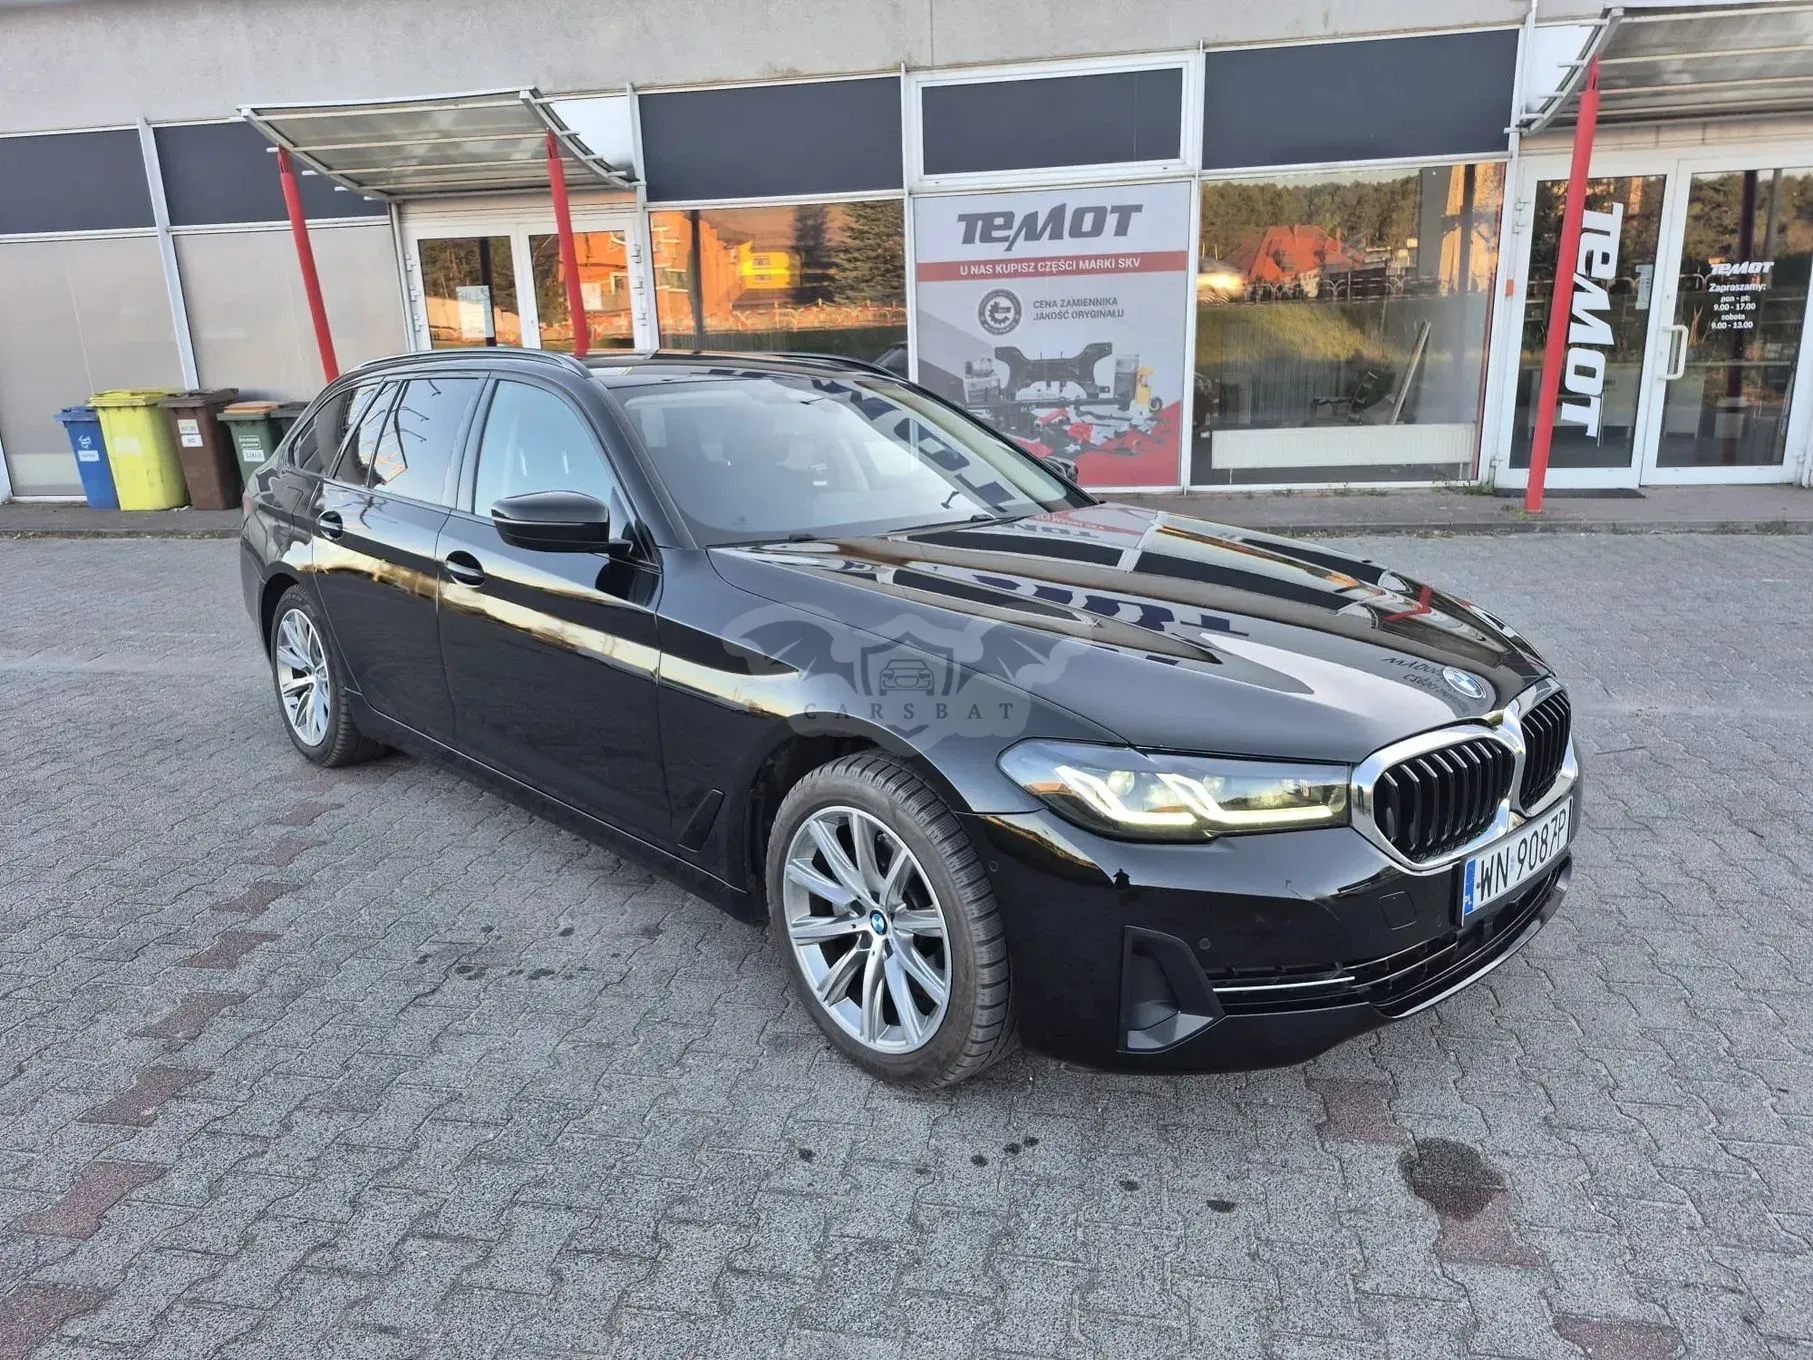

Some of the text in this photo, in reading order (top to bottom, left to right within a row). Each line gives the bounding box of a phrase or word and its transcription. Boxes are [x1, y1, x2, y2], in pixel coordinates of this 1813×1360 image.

[960, 258, 1141, 276] U NAS KUPISZ CZĘŚCI MARKI SKV
[1709, 283, 1766, 293] Zapraszamy:
[1033, 297, 1118, 309] CENA ZAMIENNIKA
[1713, 303, 1730, 311] 9.00
[1711, 321, 1727, 329] 9.00
[1480, 808, 1566, 902] WN 9087P
